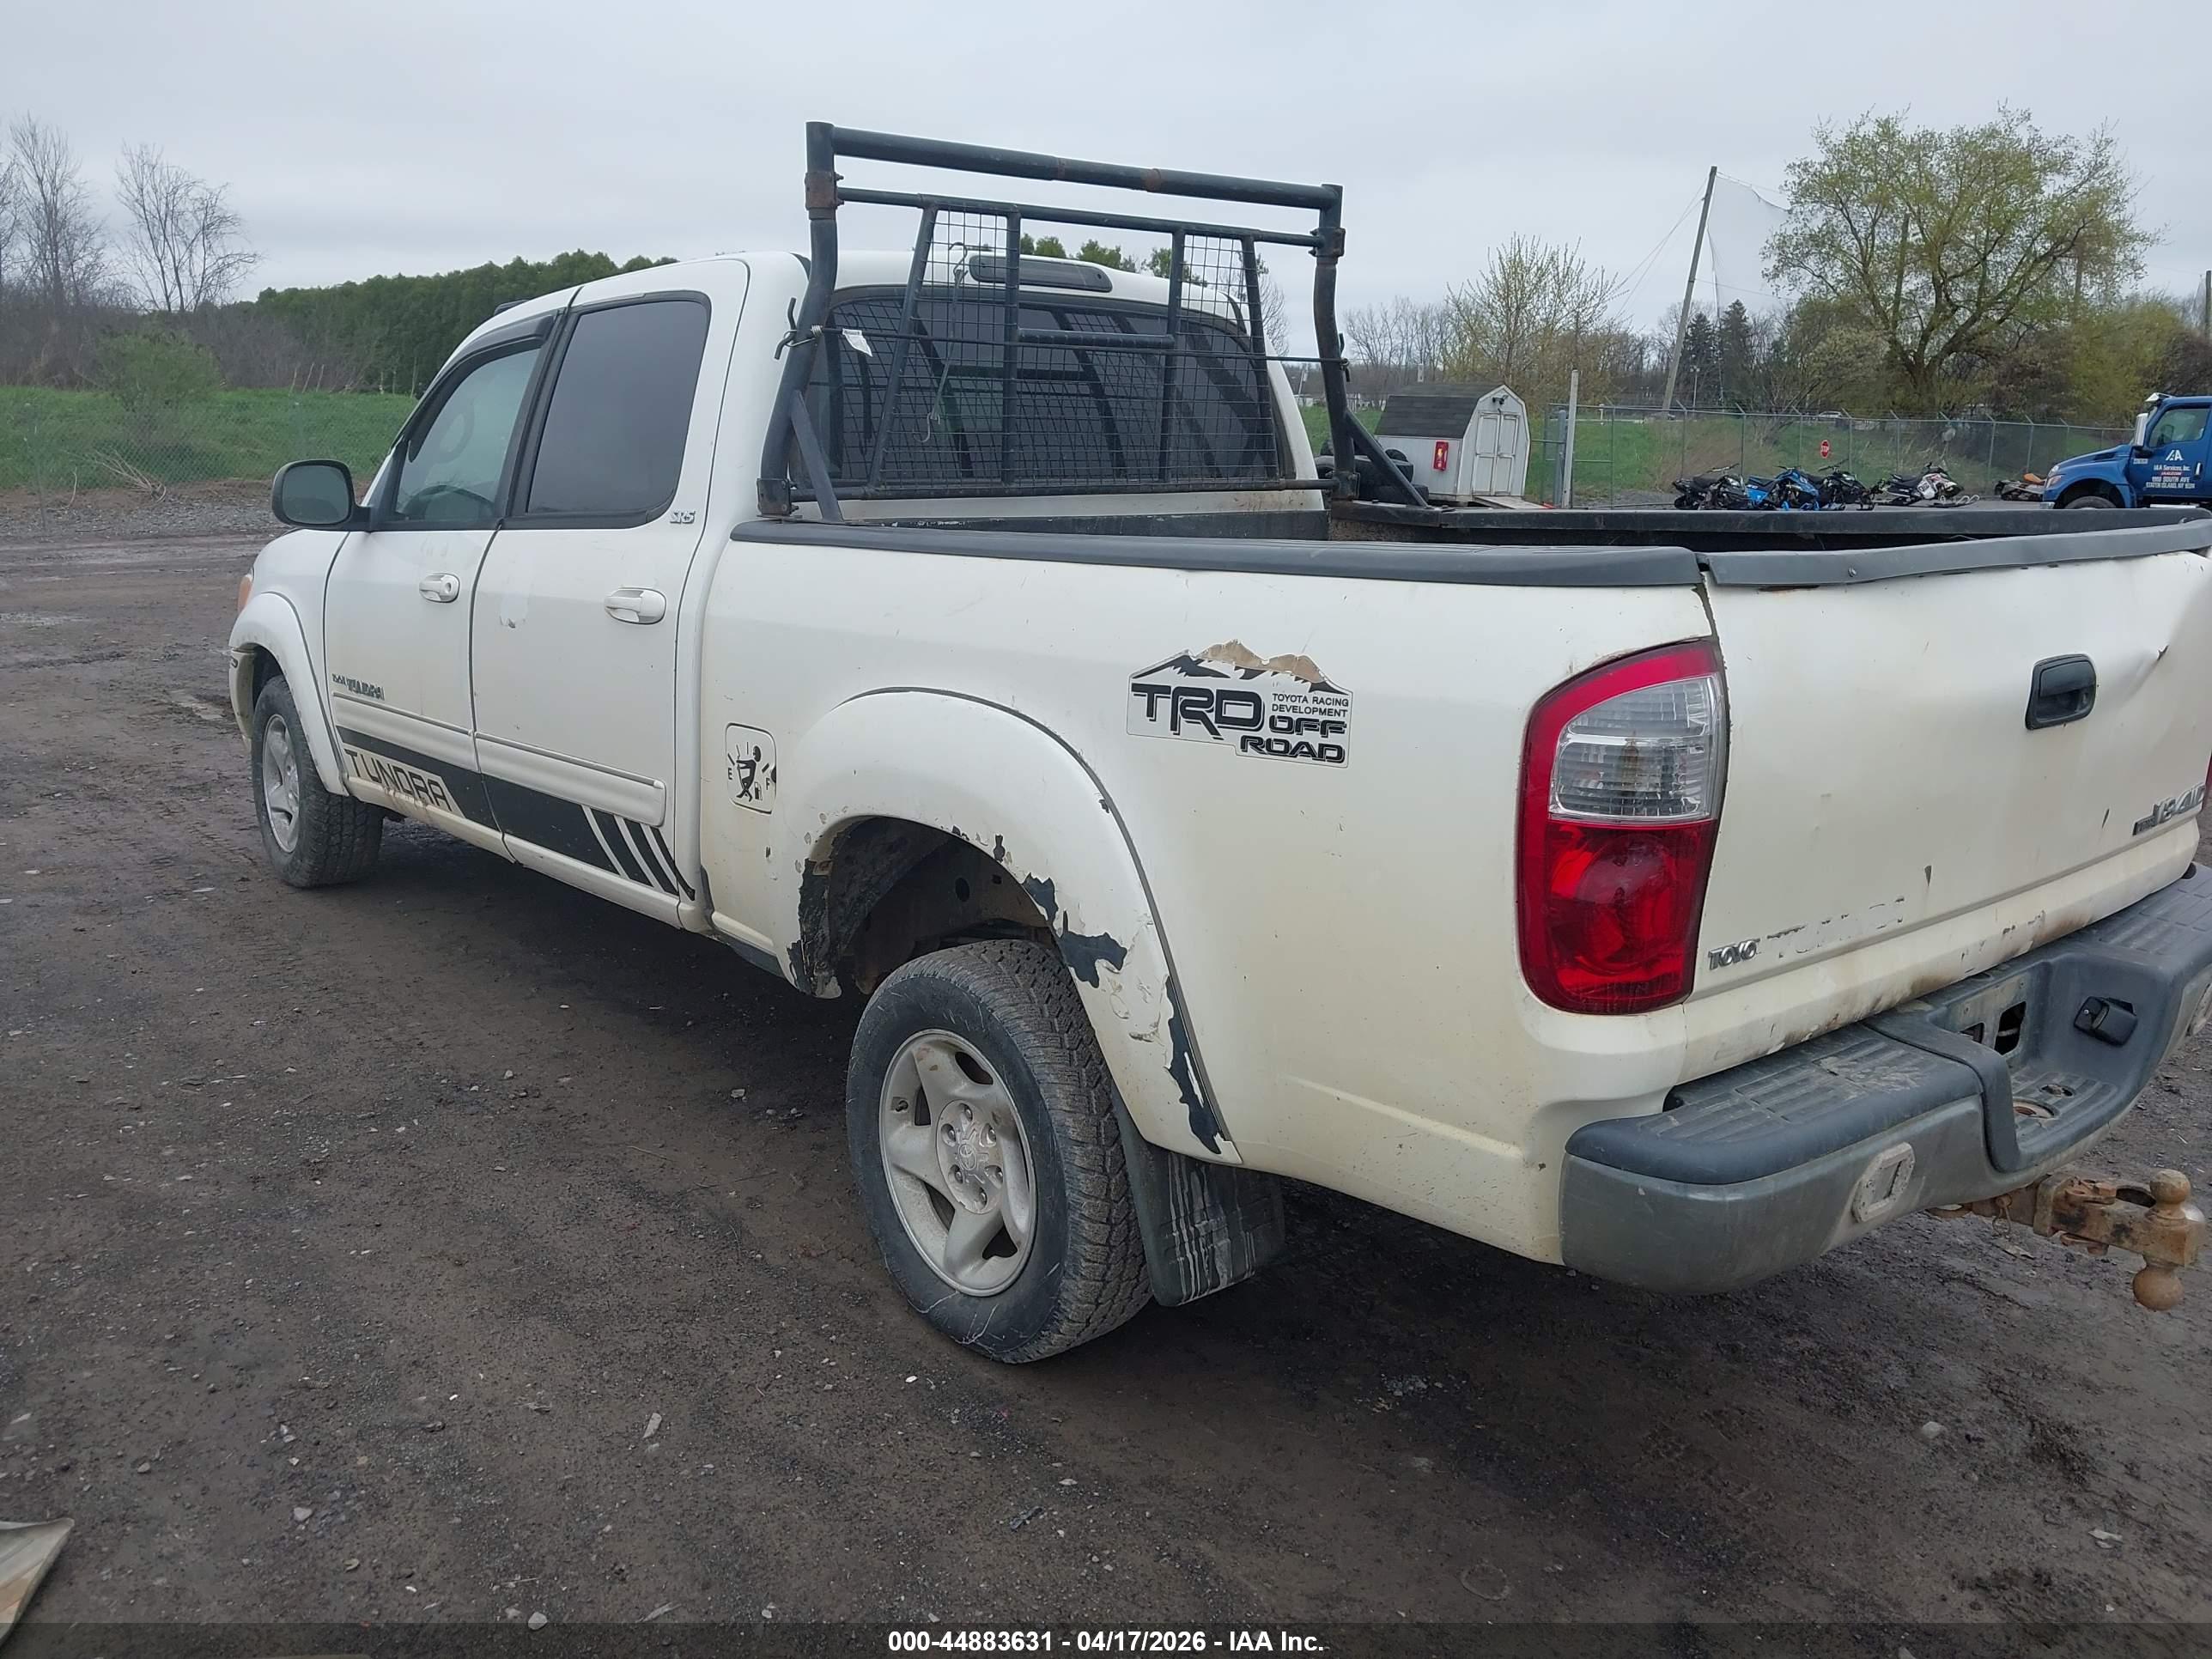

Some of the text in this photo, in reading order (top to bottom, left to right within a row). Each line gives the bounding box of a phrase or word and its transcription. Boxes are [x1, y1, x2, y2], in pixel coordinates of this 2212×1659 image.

[1131, 683, 1266, 740] TRD
[1272, 693, 1349, 708] TOYOTA RACING
[1272, 703, 1347, 718] DEVELOPMENT
[1268, 714, 1347, 738] OFF
[1240, 735, 1346, 764] ROAD
[343, 748, 453, 812] TUNDRA
